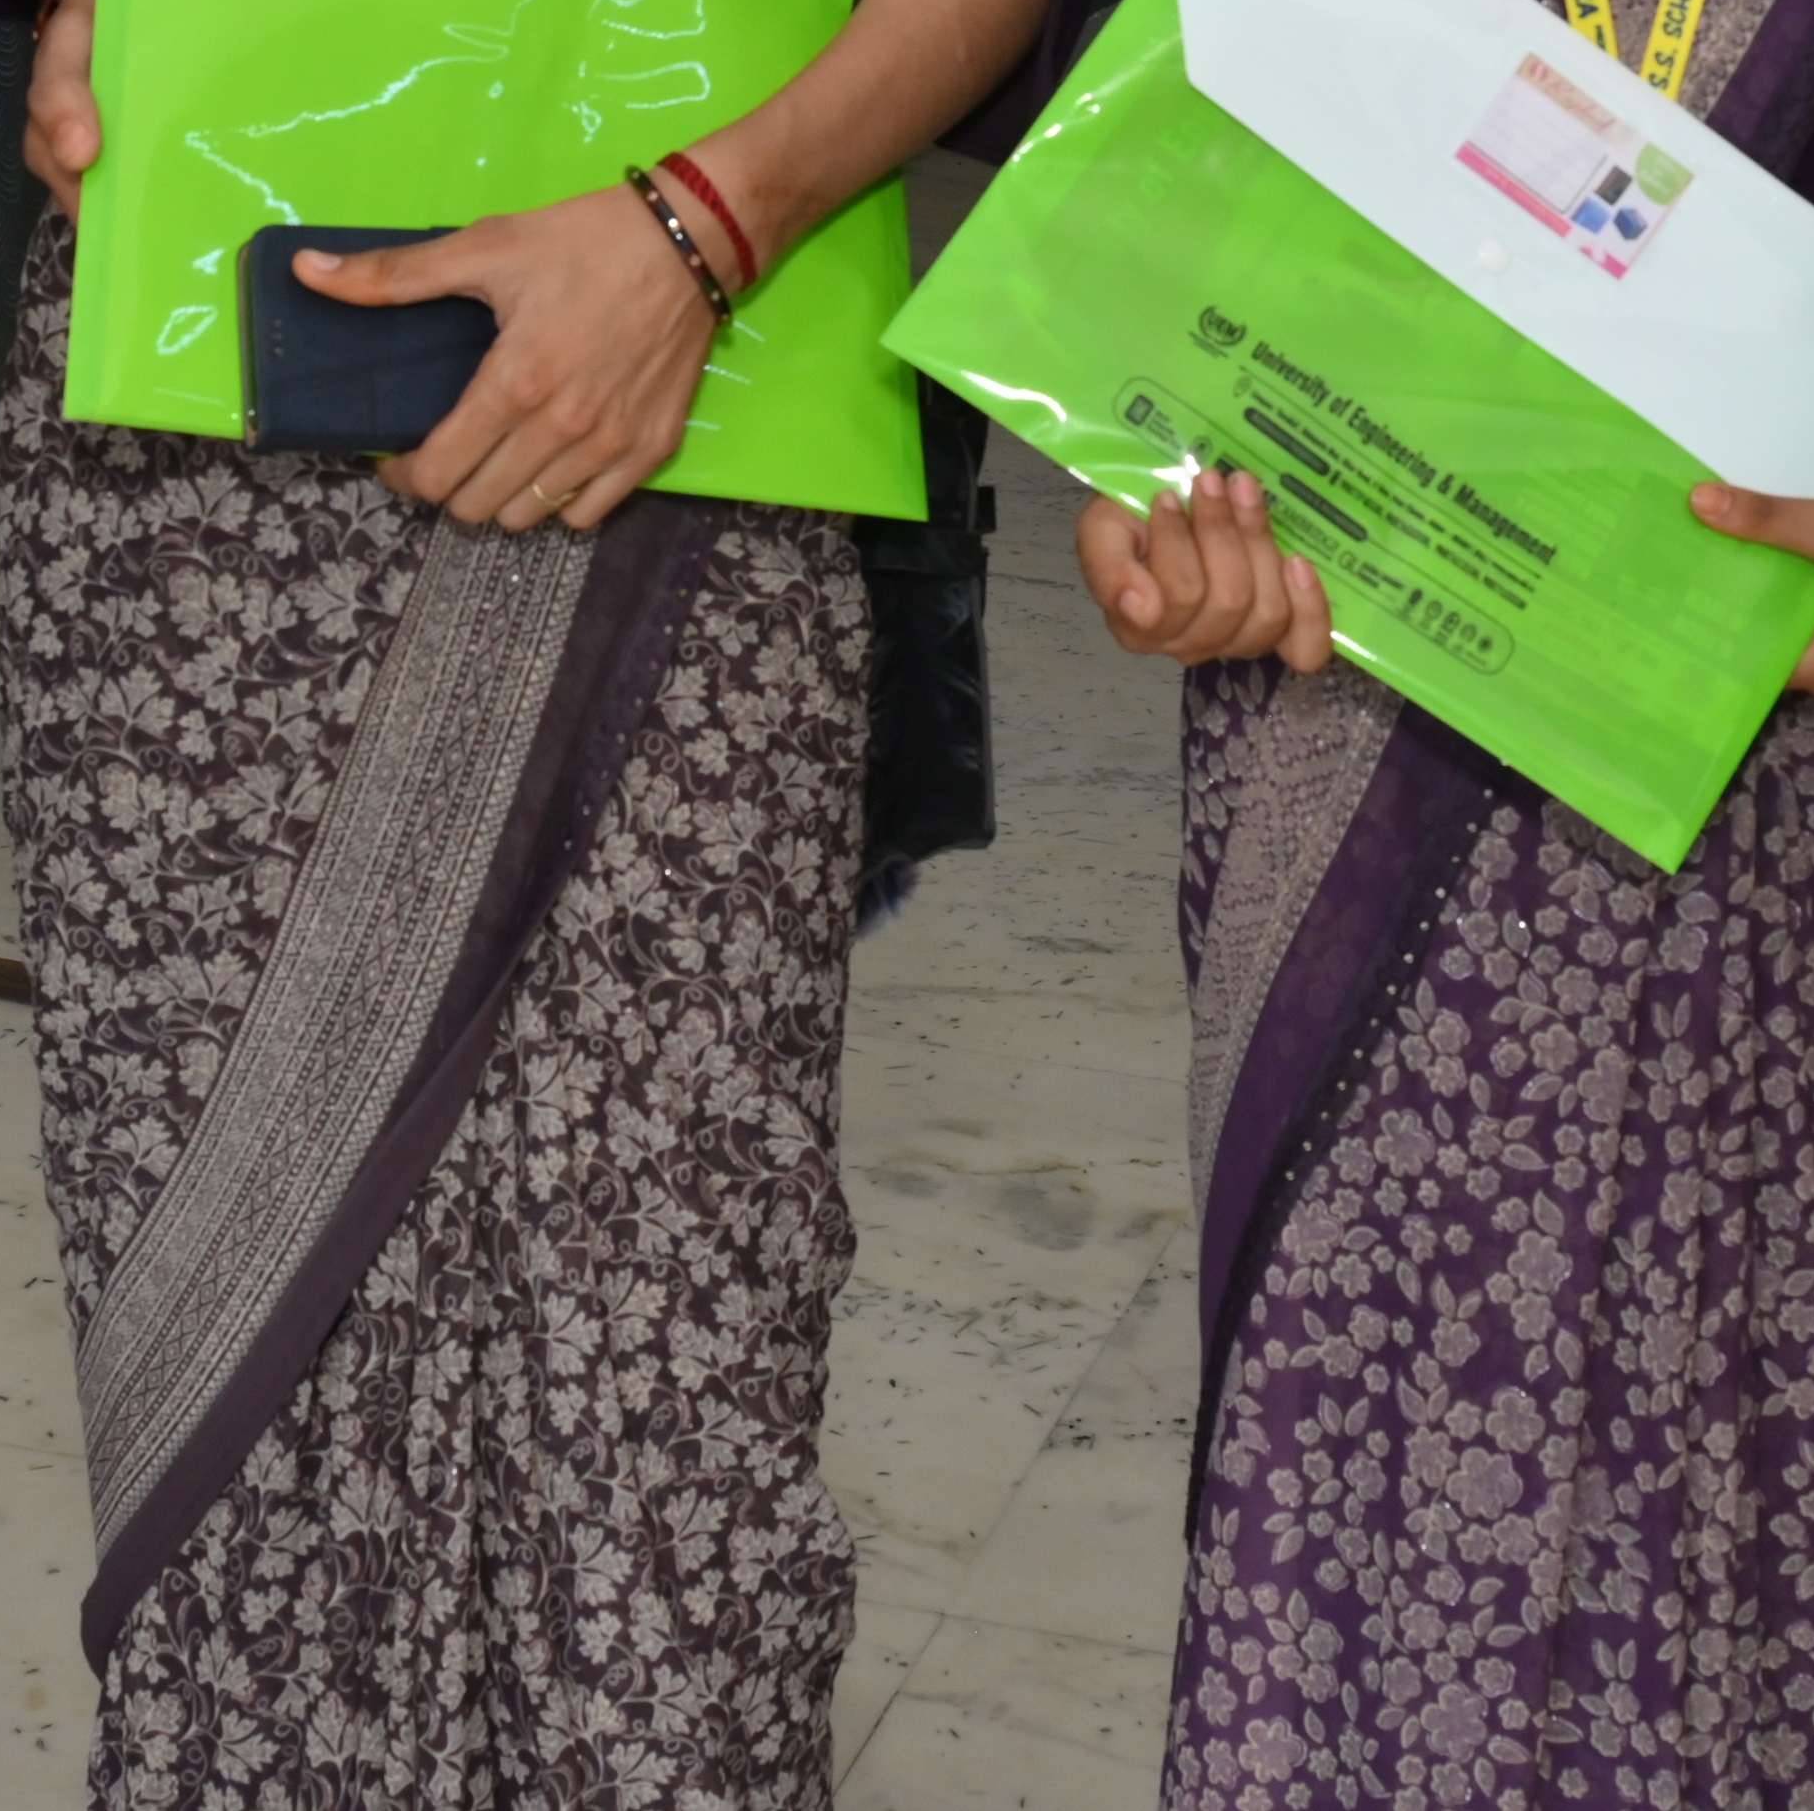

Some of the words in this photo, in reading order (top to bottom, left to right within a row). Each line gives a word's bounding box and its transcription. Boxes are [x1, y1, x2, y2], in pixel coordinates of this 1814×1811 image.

[1251, 340, 1332, 409] University
[1330, 385, 1354, 418] of
[1346, 399, 1441, 489] Engineering
[1438, 473, 1457, 498] &
[1455, 484, 1558, 567] Management
